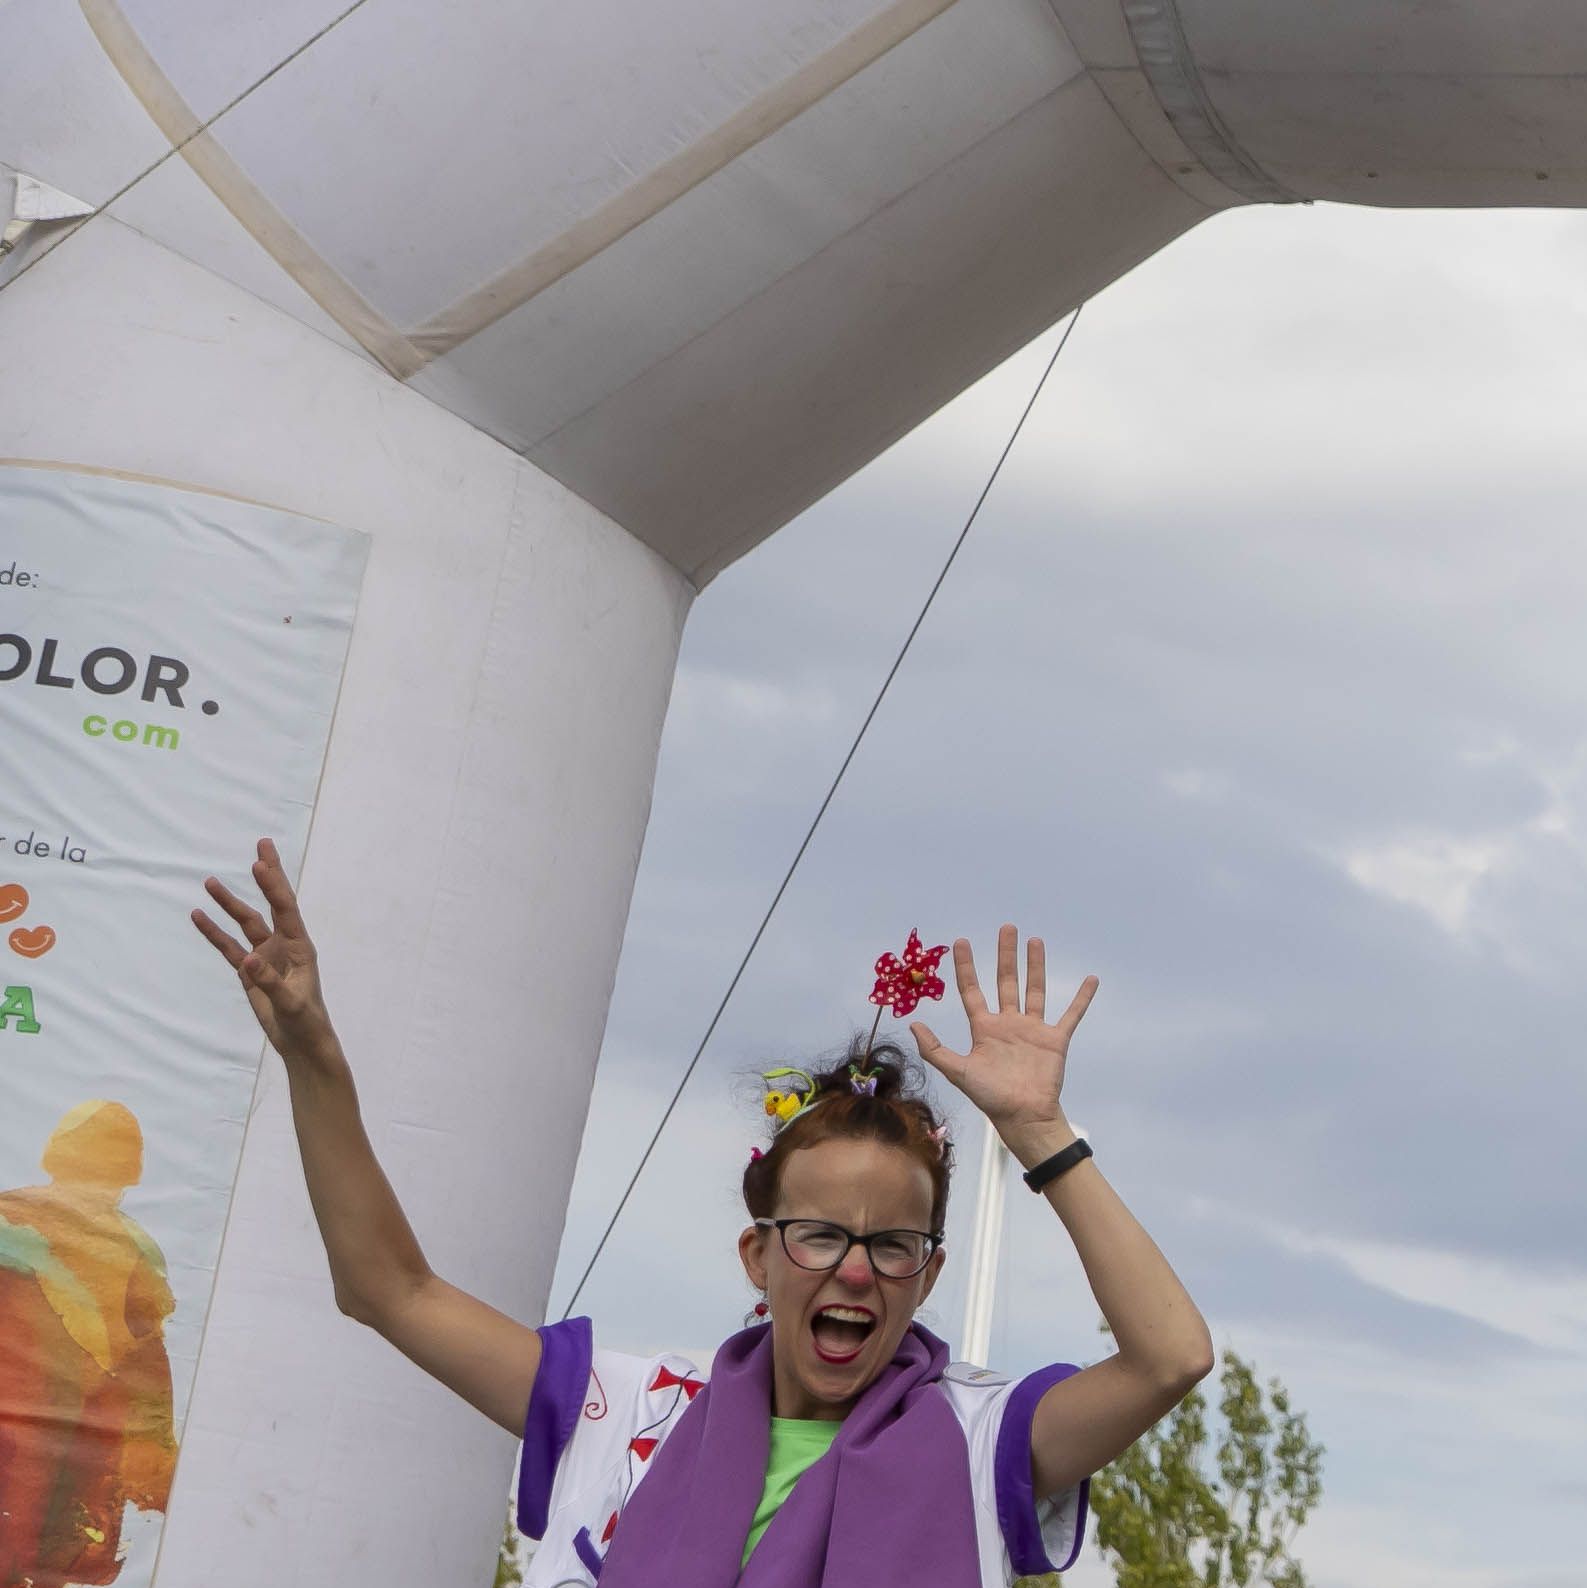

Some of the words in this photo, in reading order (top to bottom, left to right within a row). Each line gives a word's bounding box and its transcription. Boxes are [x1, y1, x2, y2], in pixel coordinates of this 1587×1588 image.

[82, 714, 180, 750] com
[14, 831, 50, 858] de
[60, 836, 87, 863] la
